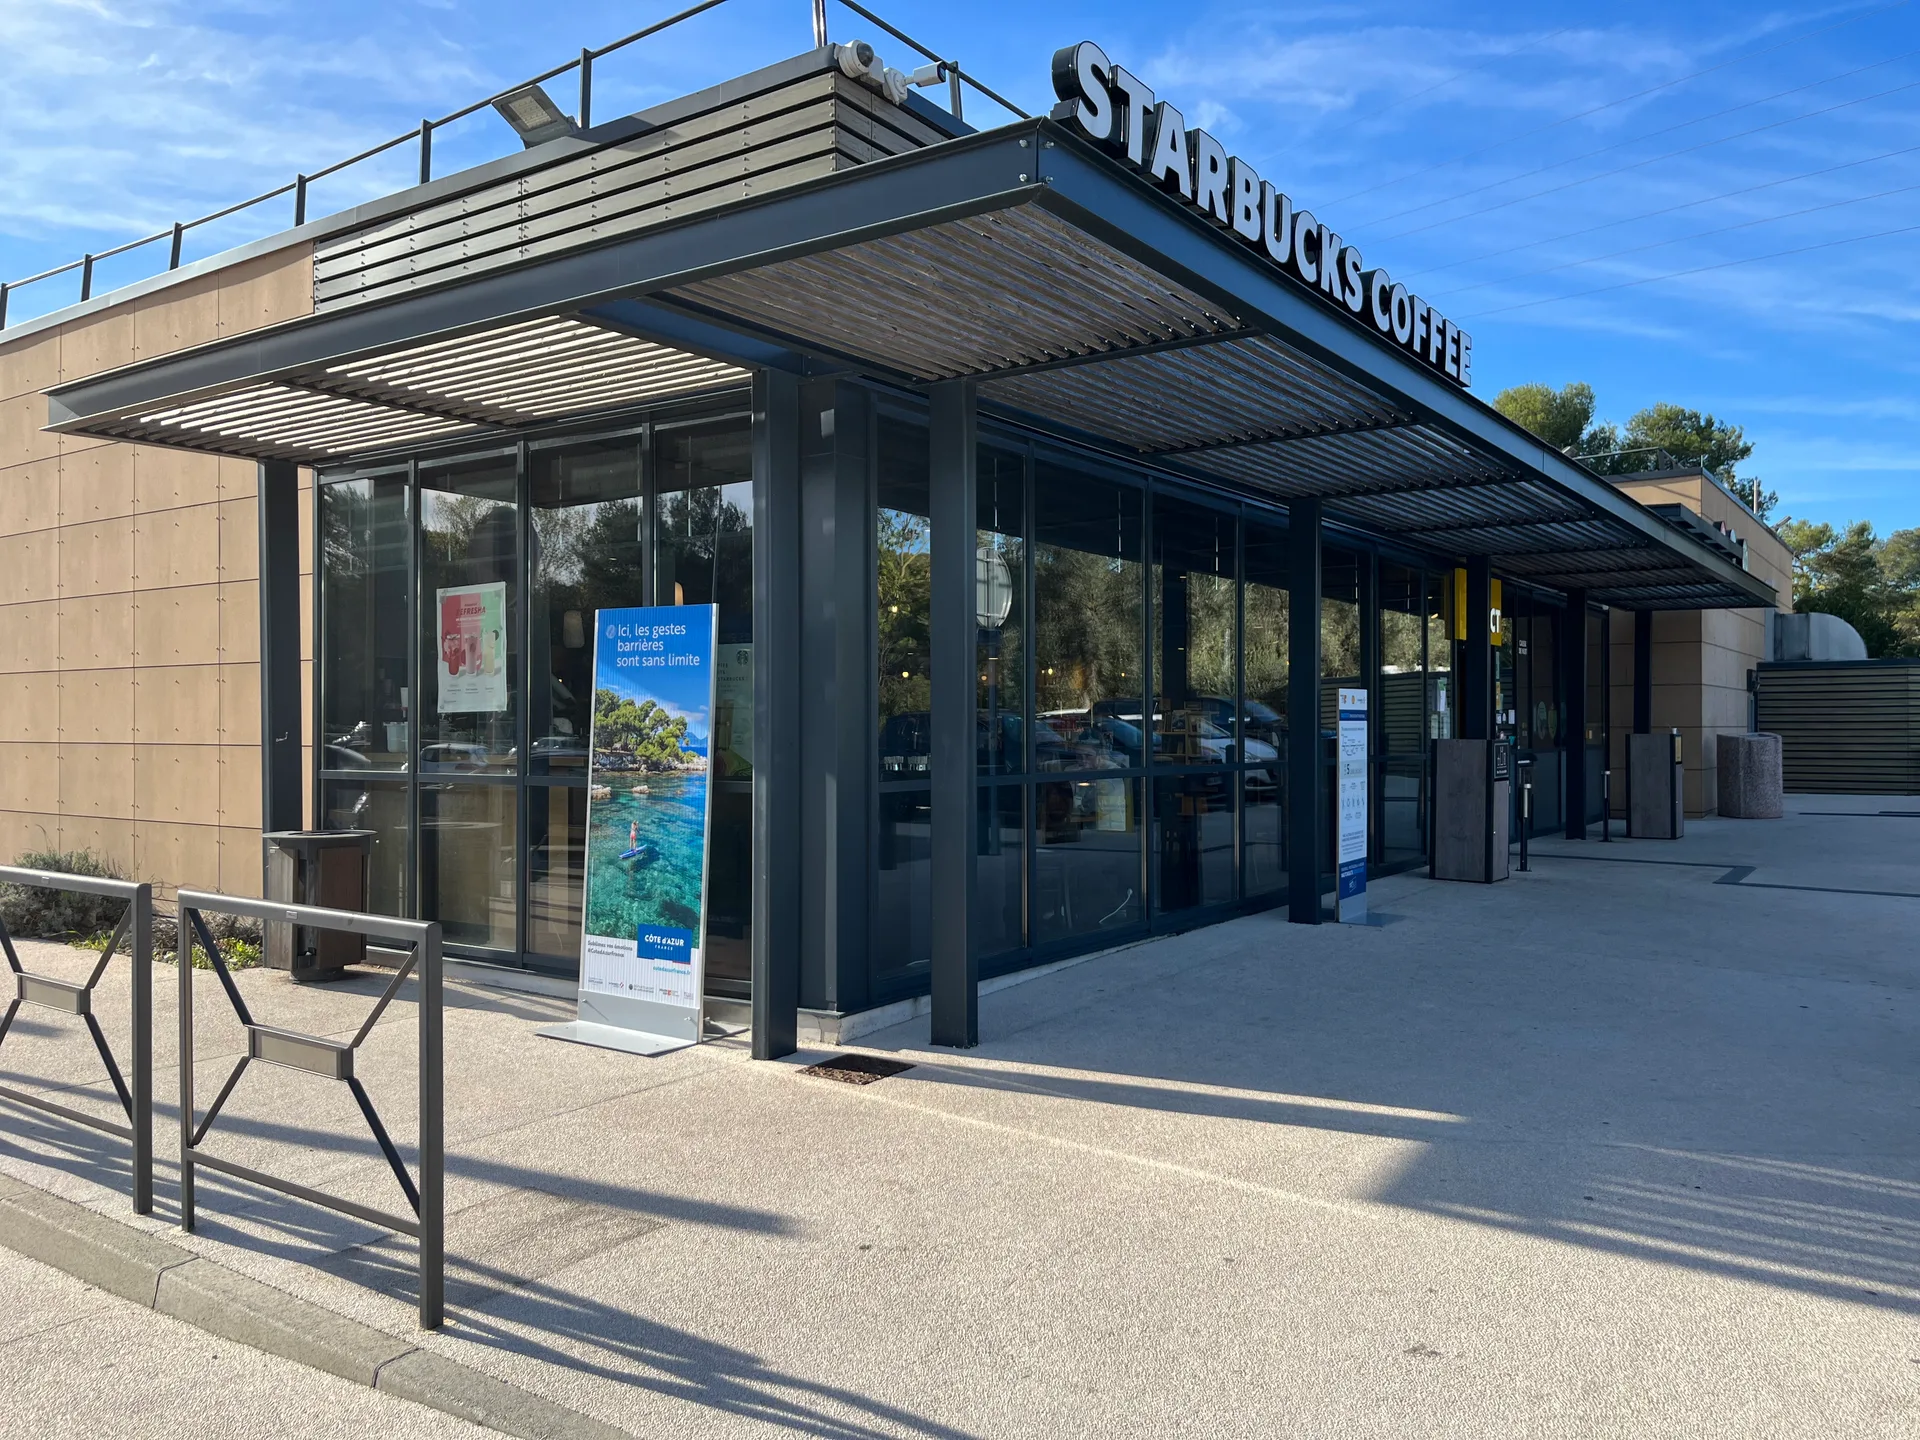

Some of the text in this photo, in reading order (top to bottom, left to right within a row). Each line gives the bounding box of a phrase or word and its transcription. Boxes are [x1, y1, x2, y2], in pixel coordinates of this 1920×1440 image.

[1053, 40, 1473, 388] STARBUCKS COFFEE
[618, 623, 686, 638] Ici, les gestes
[617, 639, 664, 651] barrières
[616, 653, 700, 666] sont sans limite
[644, 934, 661, 943] CÔTE
